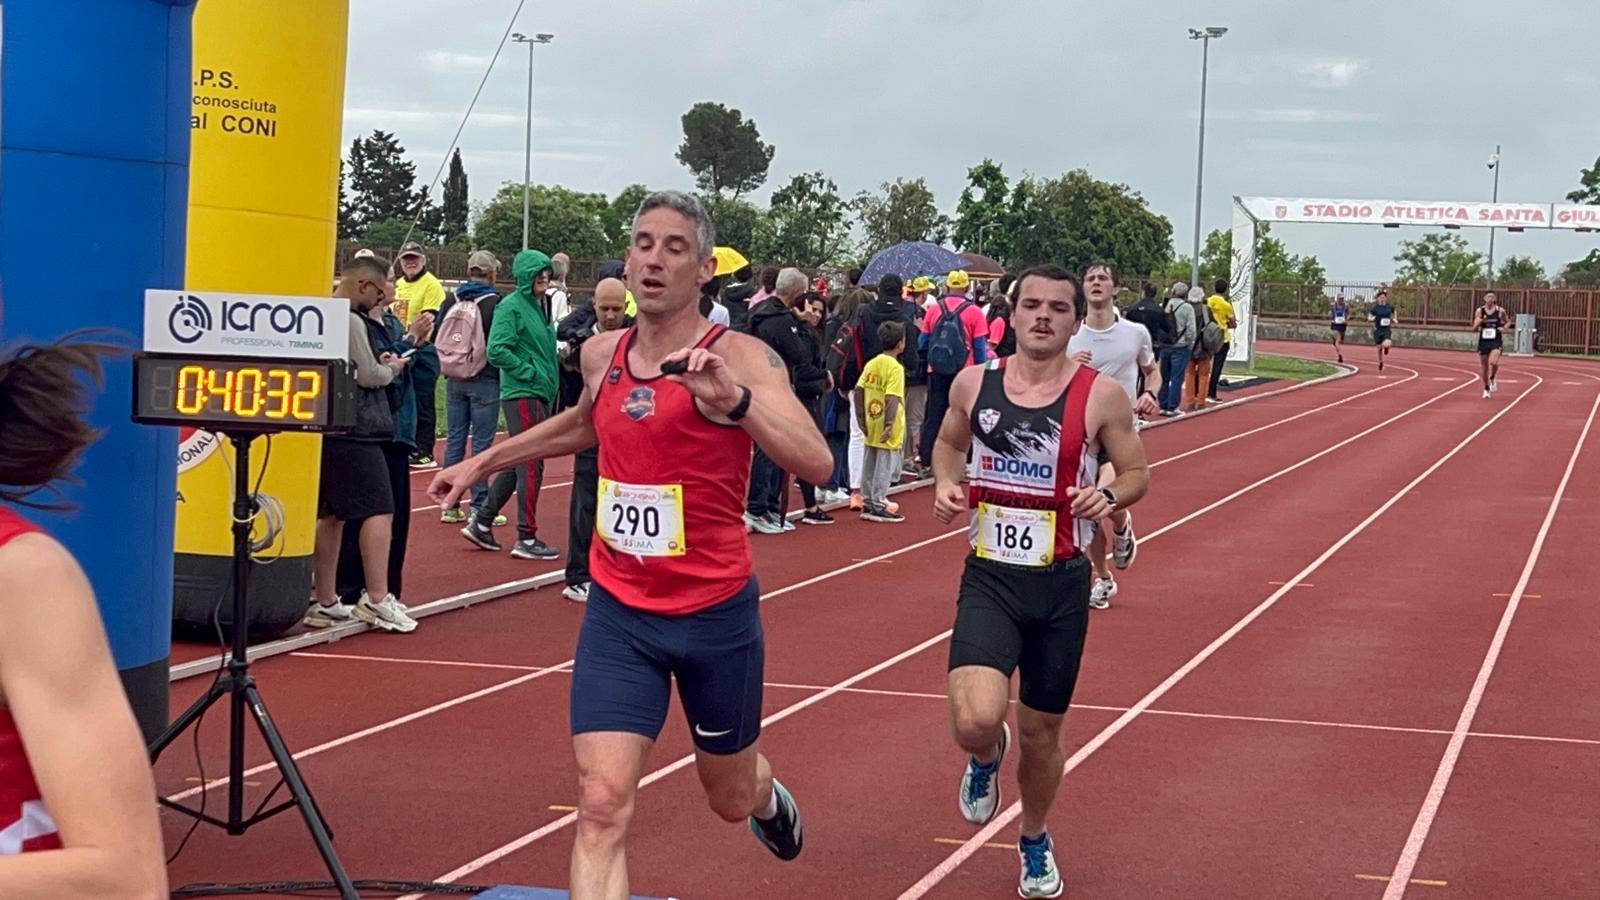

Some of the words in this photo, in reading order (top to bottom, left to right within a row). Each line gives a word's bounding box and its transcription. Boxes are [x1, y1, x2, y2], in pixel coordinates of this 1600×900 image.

[193, 95, 277, 113] conosciuta
[190, 113, 207, 129] al
[221, 115, 276, 137] CONI
[1303, 204, 1372, 218] STADIO
[1382, 206, 1469, 221] ATLETICA
[1478, 208, 1545, 222] SANTA
[220, 336, 285, 348] PROFESSIONAL
[288, 340, 324, 349] TIMING
[176, 365, 322, 420] 0:40:32
[993, 457, 1052, 479] DOMO
[612, 503, 659, 537] 290
[995, 522, 1032, 550] 186
